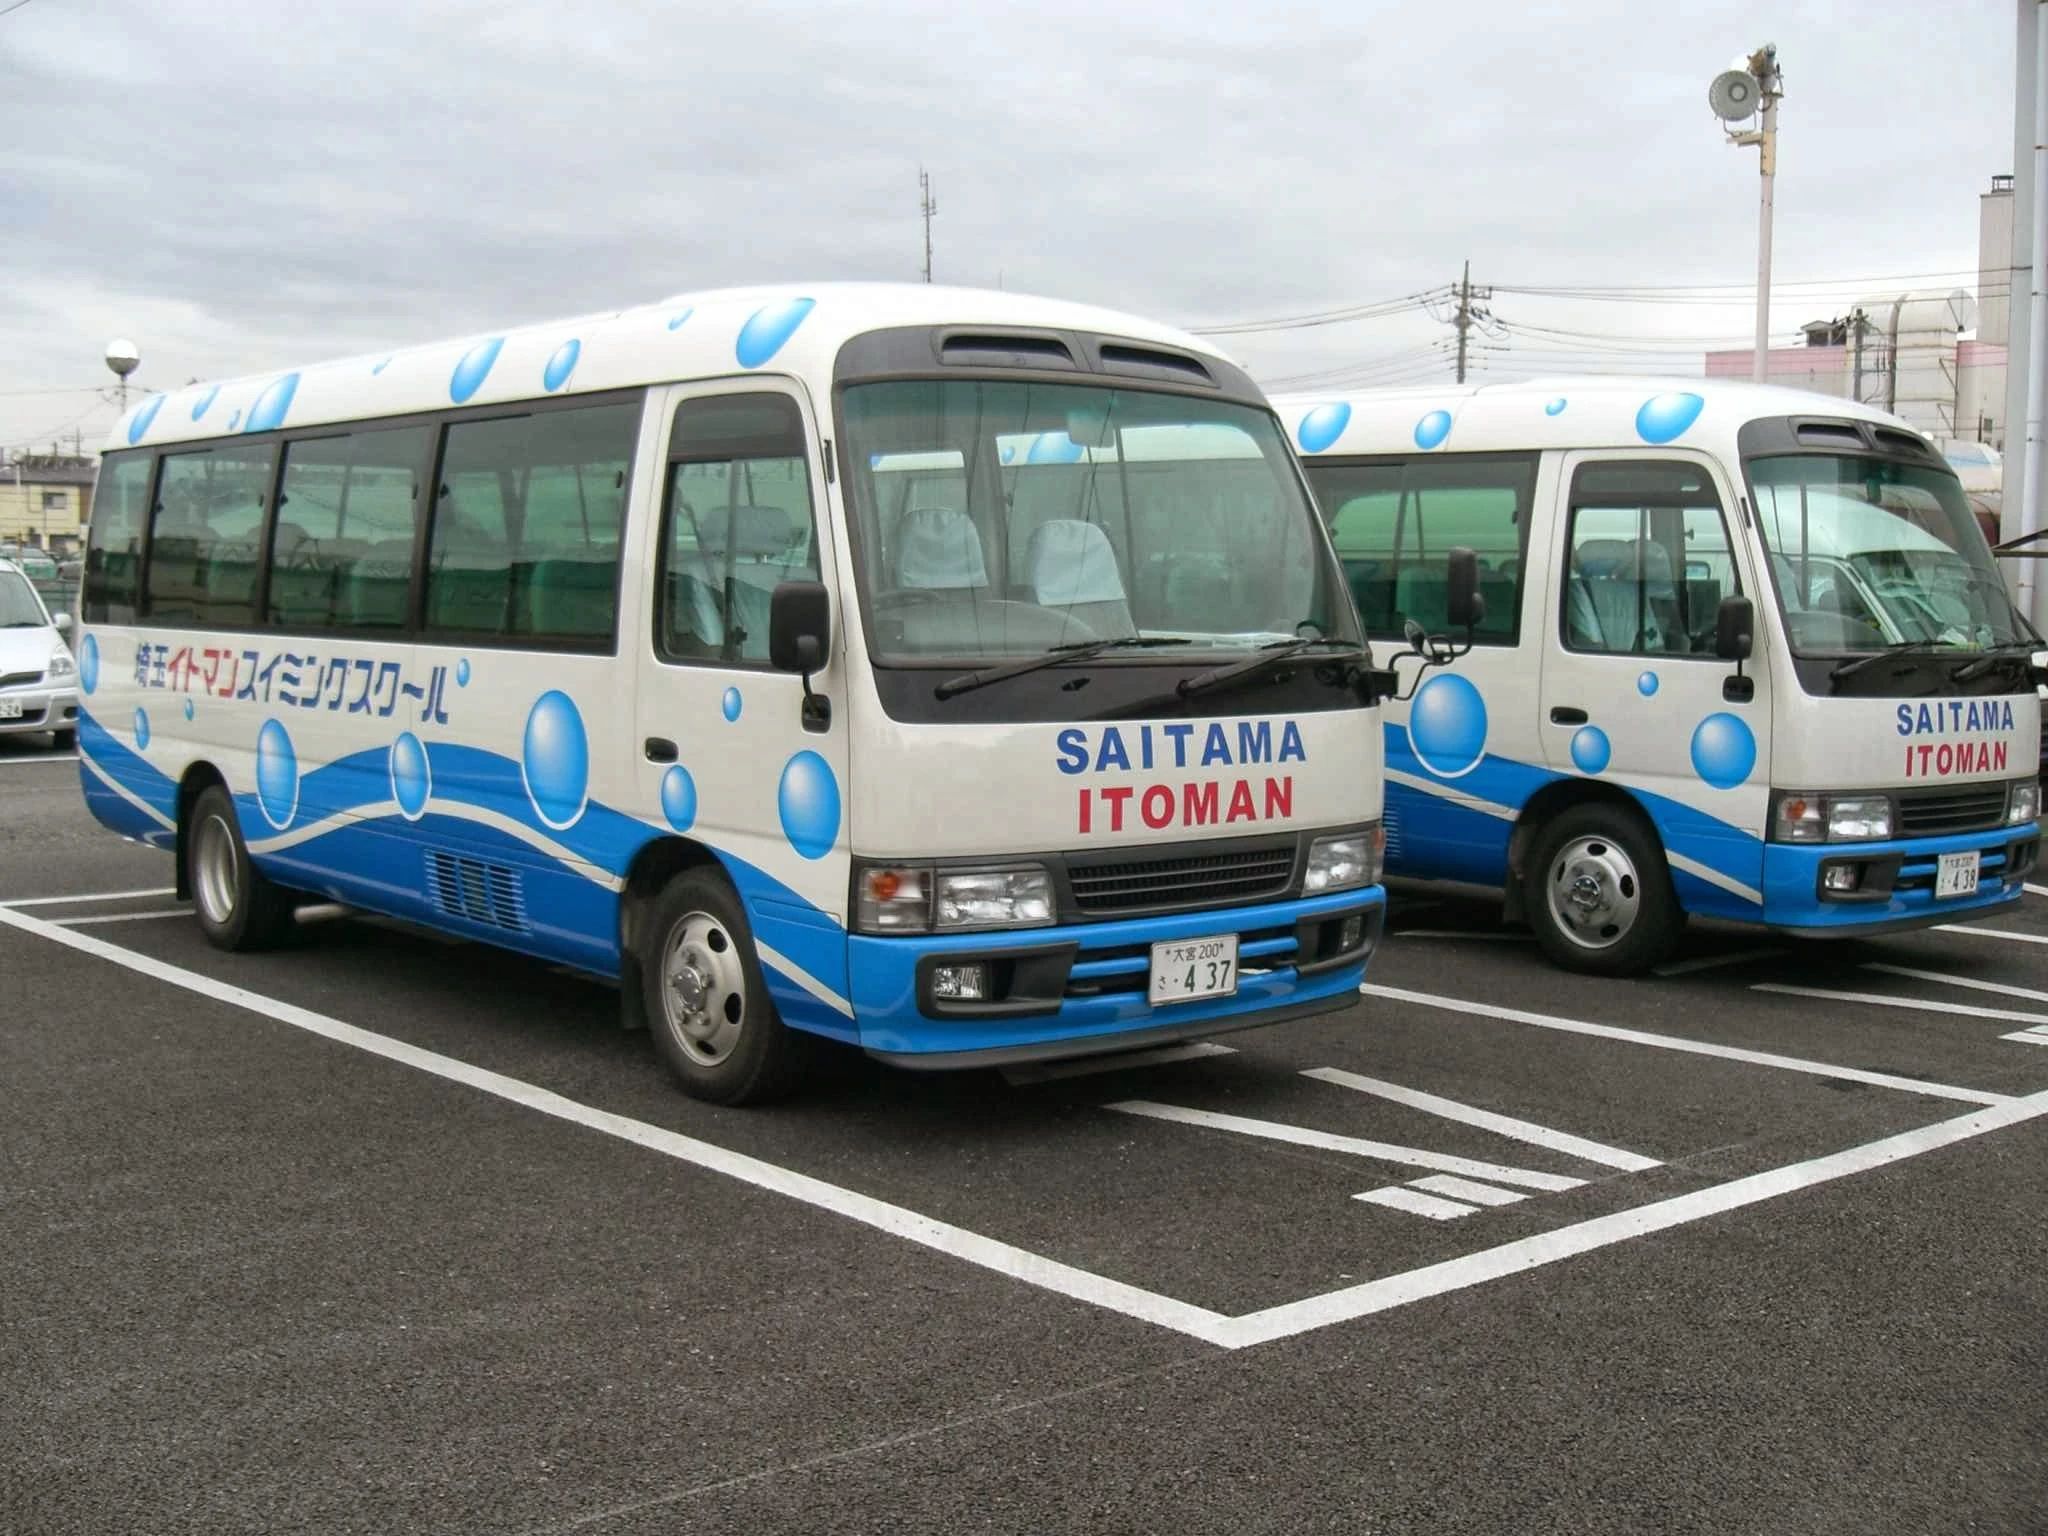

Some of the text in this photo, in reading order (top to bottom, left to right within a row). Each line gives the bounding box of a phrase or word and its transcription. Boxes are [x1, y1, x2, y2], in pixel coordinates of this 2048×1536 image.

[133, 641, 449, 725] 埼玉イトマンスイミングスクール
[1897, 701, 2015, 737] SAITAMA
[1056, 720, 1307, 775] SAITAMA
[1906, 741, 2008, 777] ITOMAN
[1078, 776, 1293, 834] ITOMAN
[1173, 943, 1219, 962] 大宮 200
